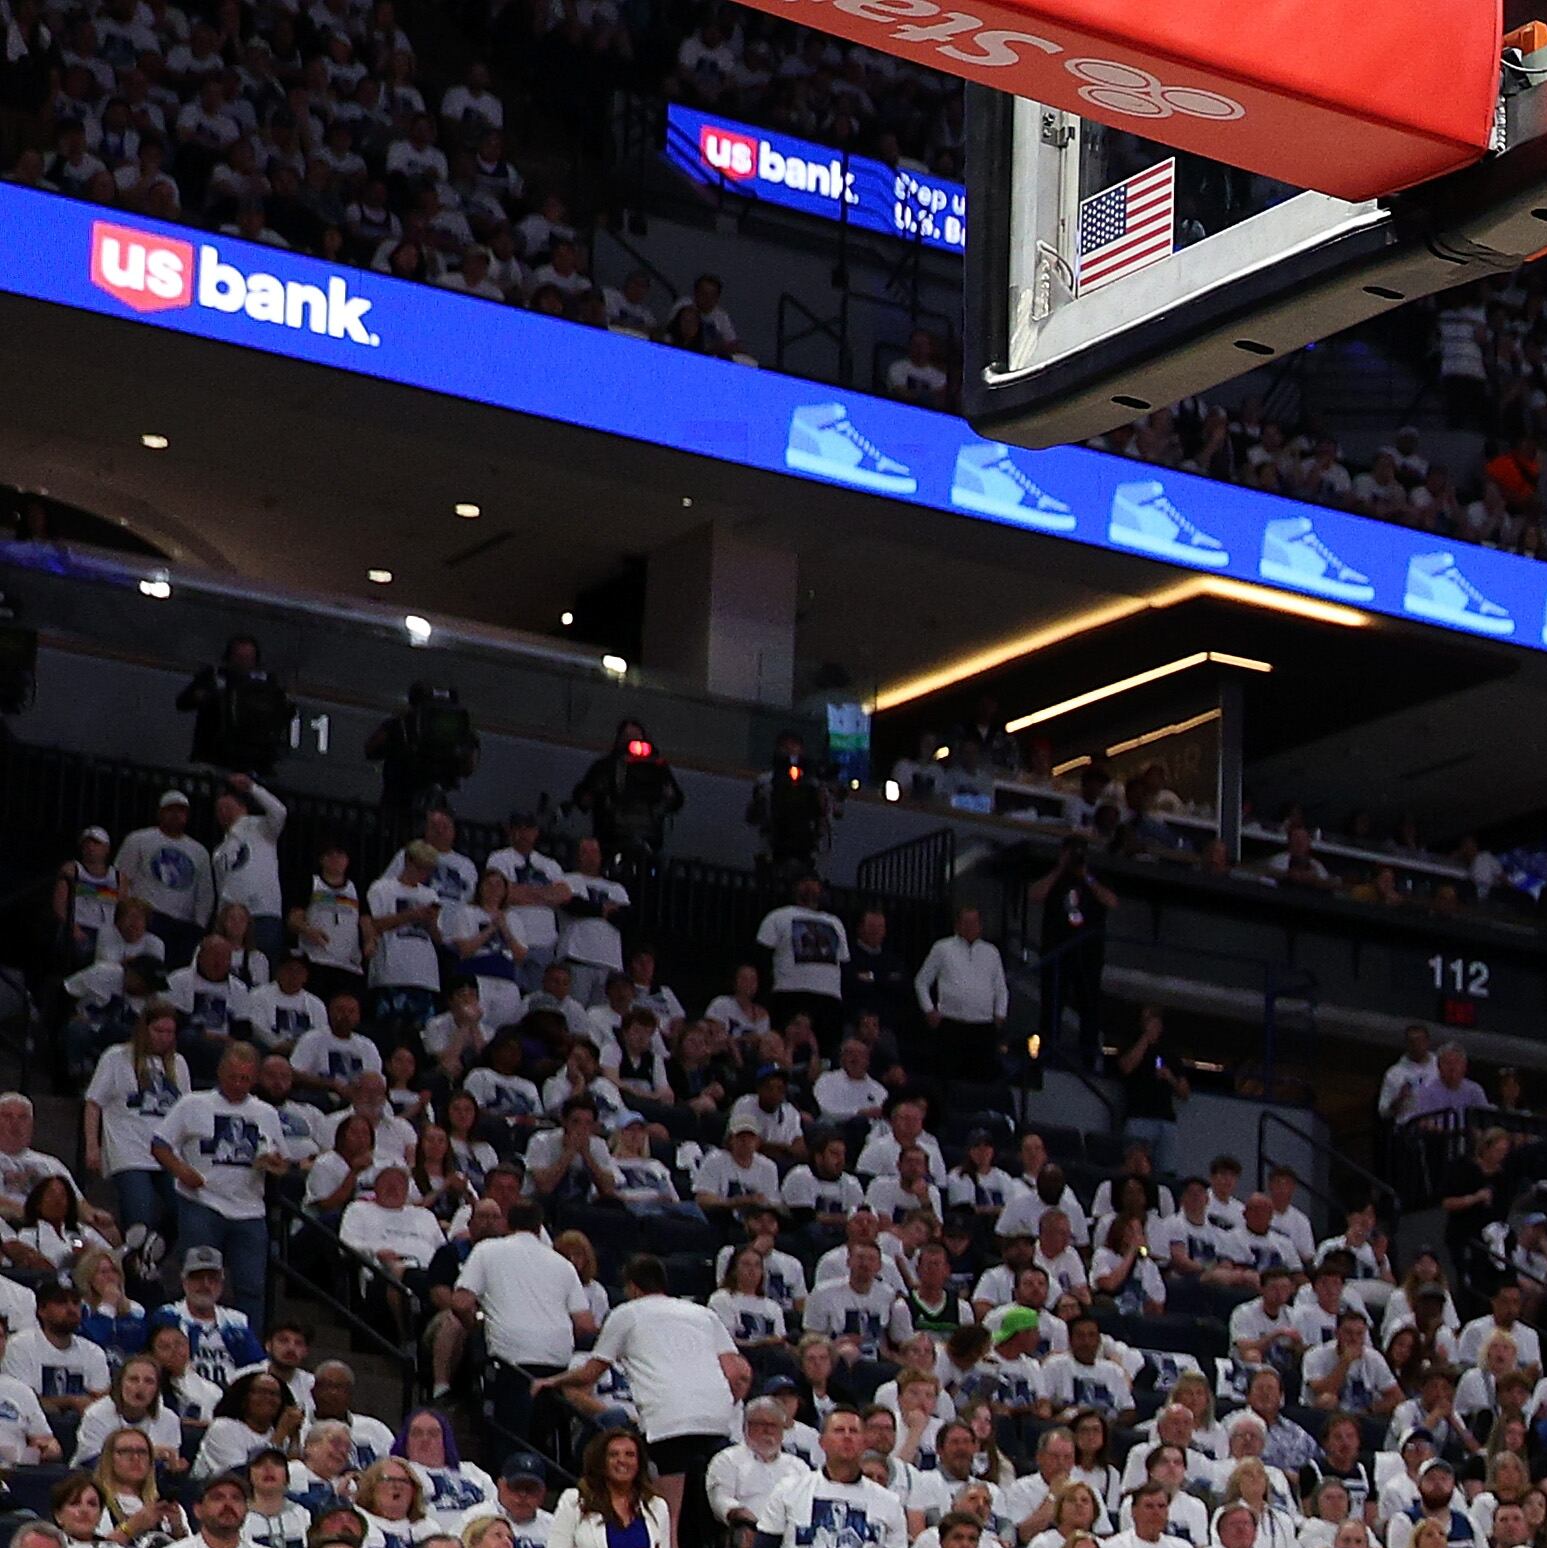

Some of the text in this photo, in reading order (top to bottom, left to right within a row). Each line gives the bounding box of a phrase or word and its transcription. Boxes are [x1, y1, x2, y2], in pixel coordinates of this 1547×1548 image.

[832, 0, 1064, 67] Sta
[704, 134, 753, 175] us
[102, 238, 185, 298] us
[1428, 954, 1490, 998] 112
